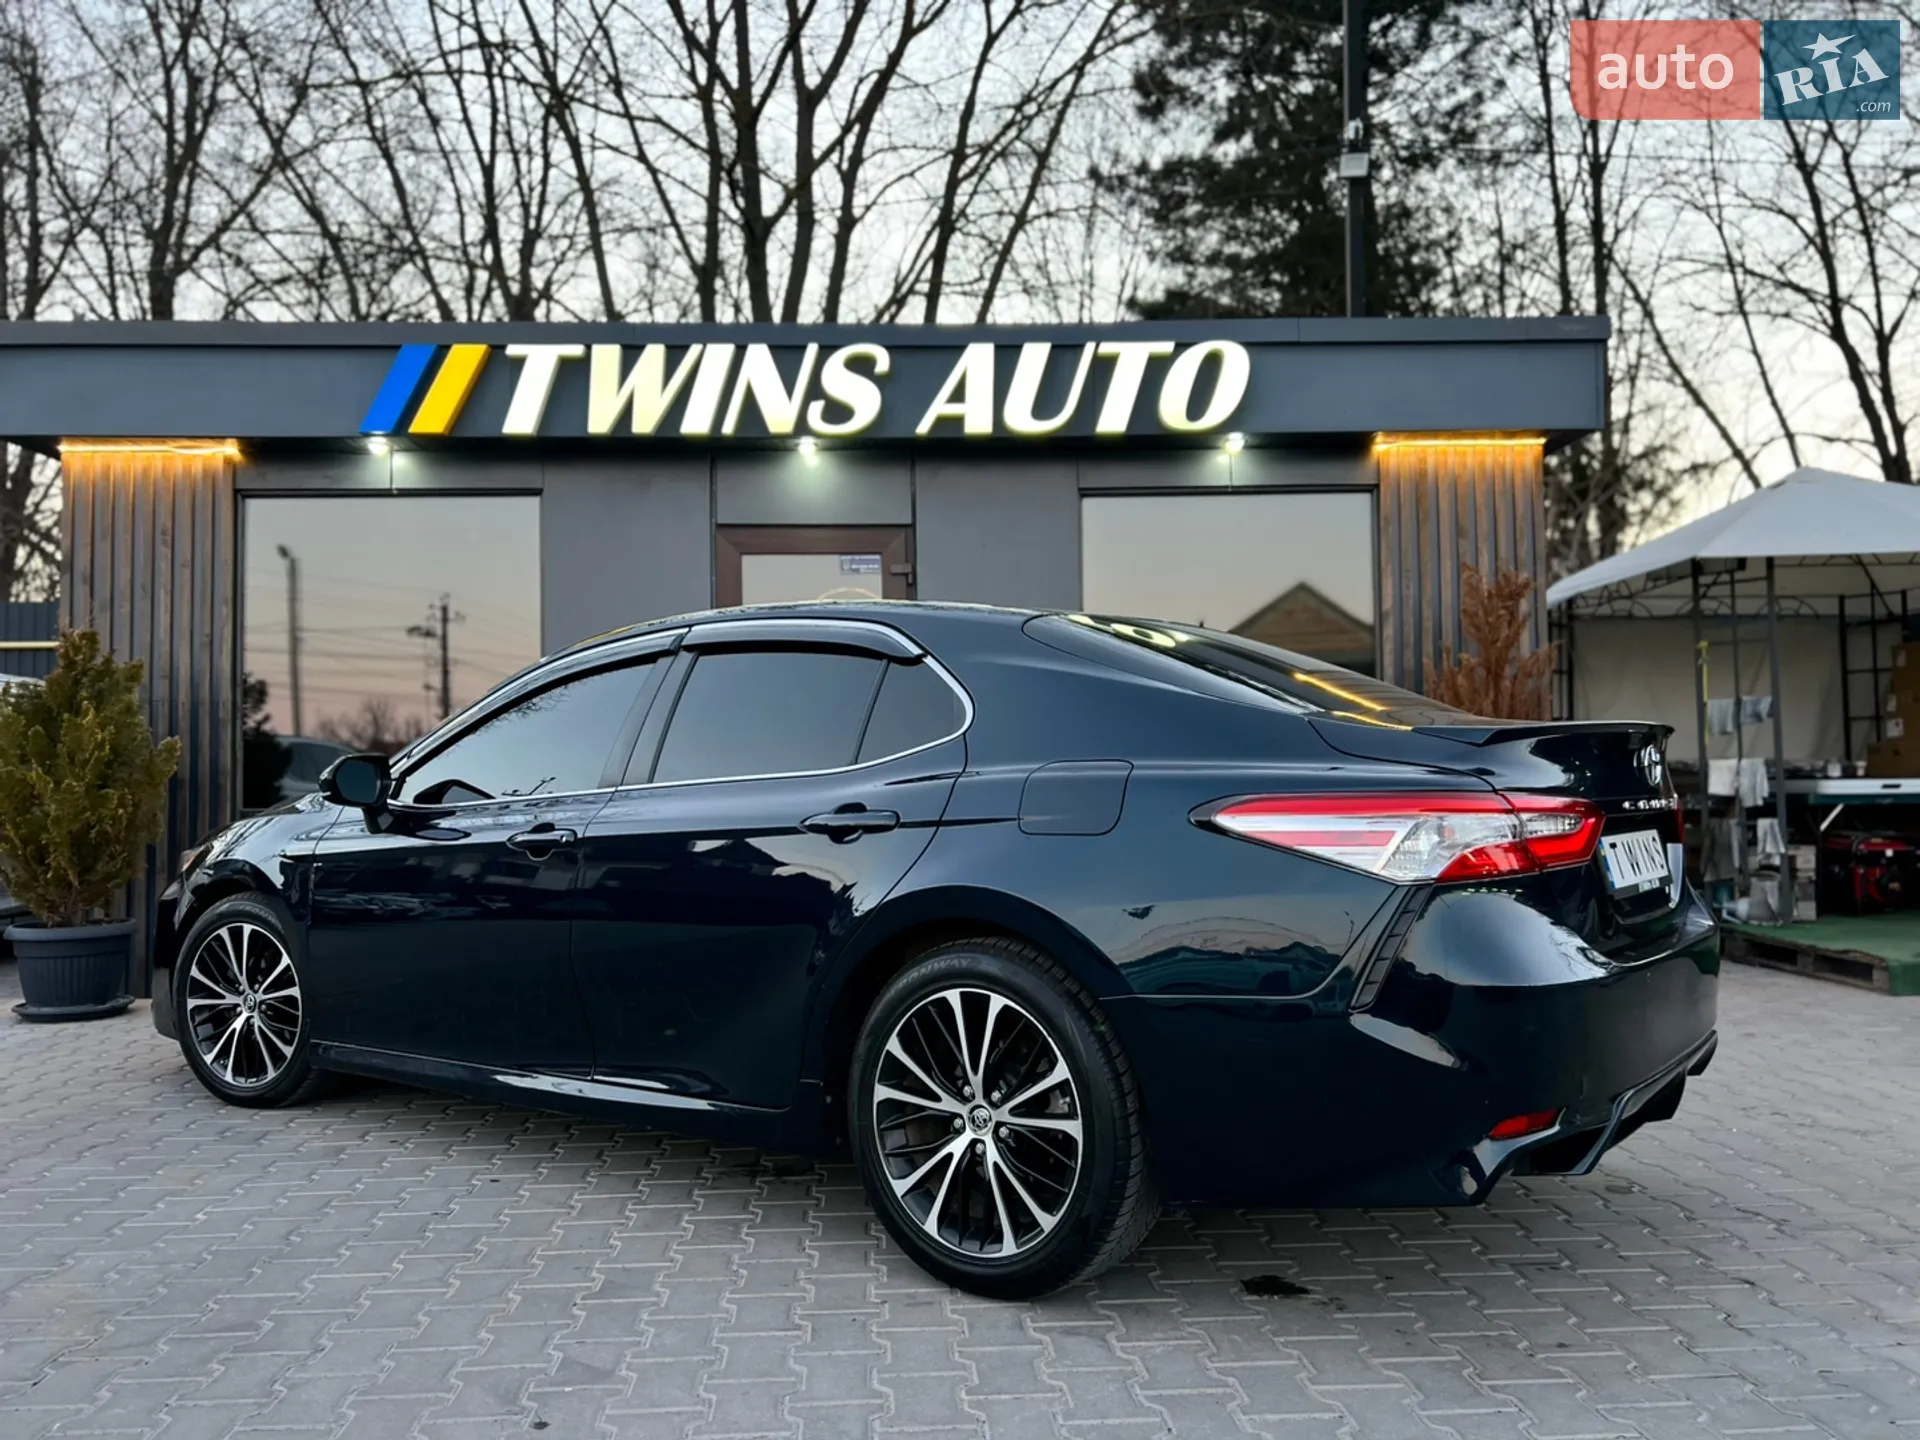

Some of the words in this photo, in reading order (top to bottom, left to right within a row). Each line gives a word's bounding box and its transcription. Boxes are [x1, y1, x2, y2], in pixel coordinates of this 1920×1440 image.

[501, 342, 891, 437] TWINS
[914, 339, 1251, 437] AUTO
[1608, 835, 1665, 880] TWINS
